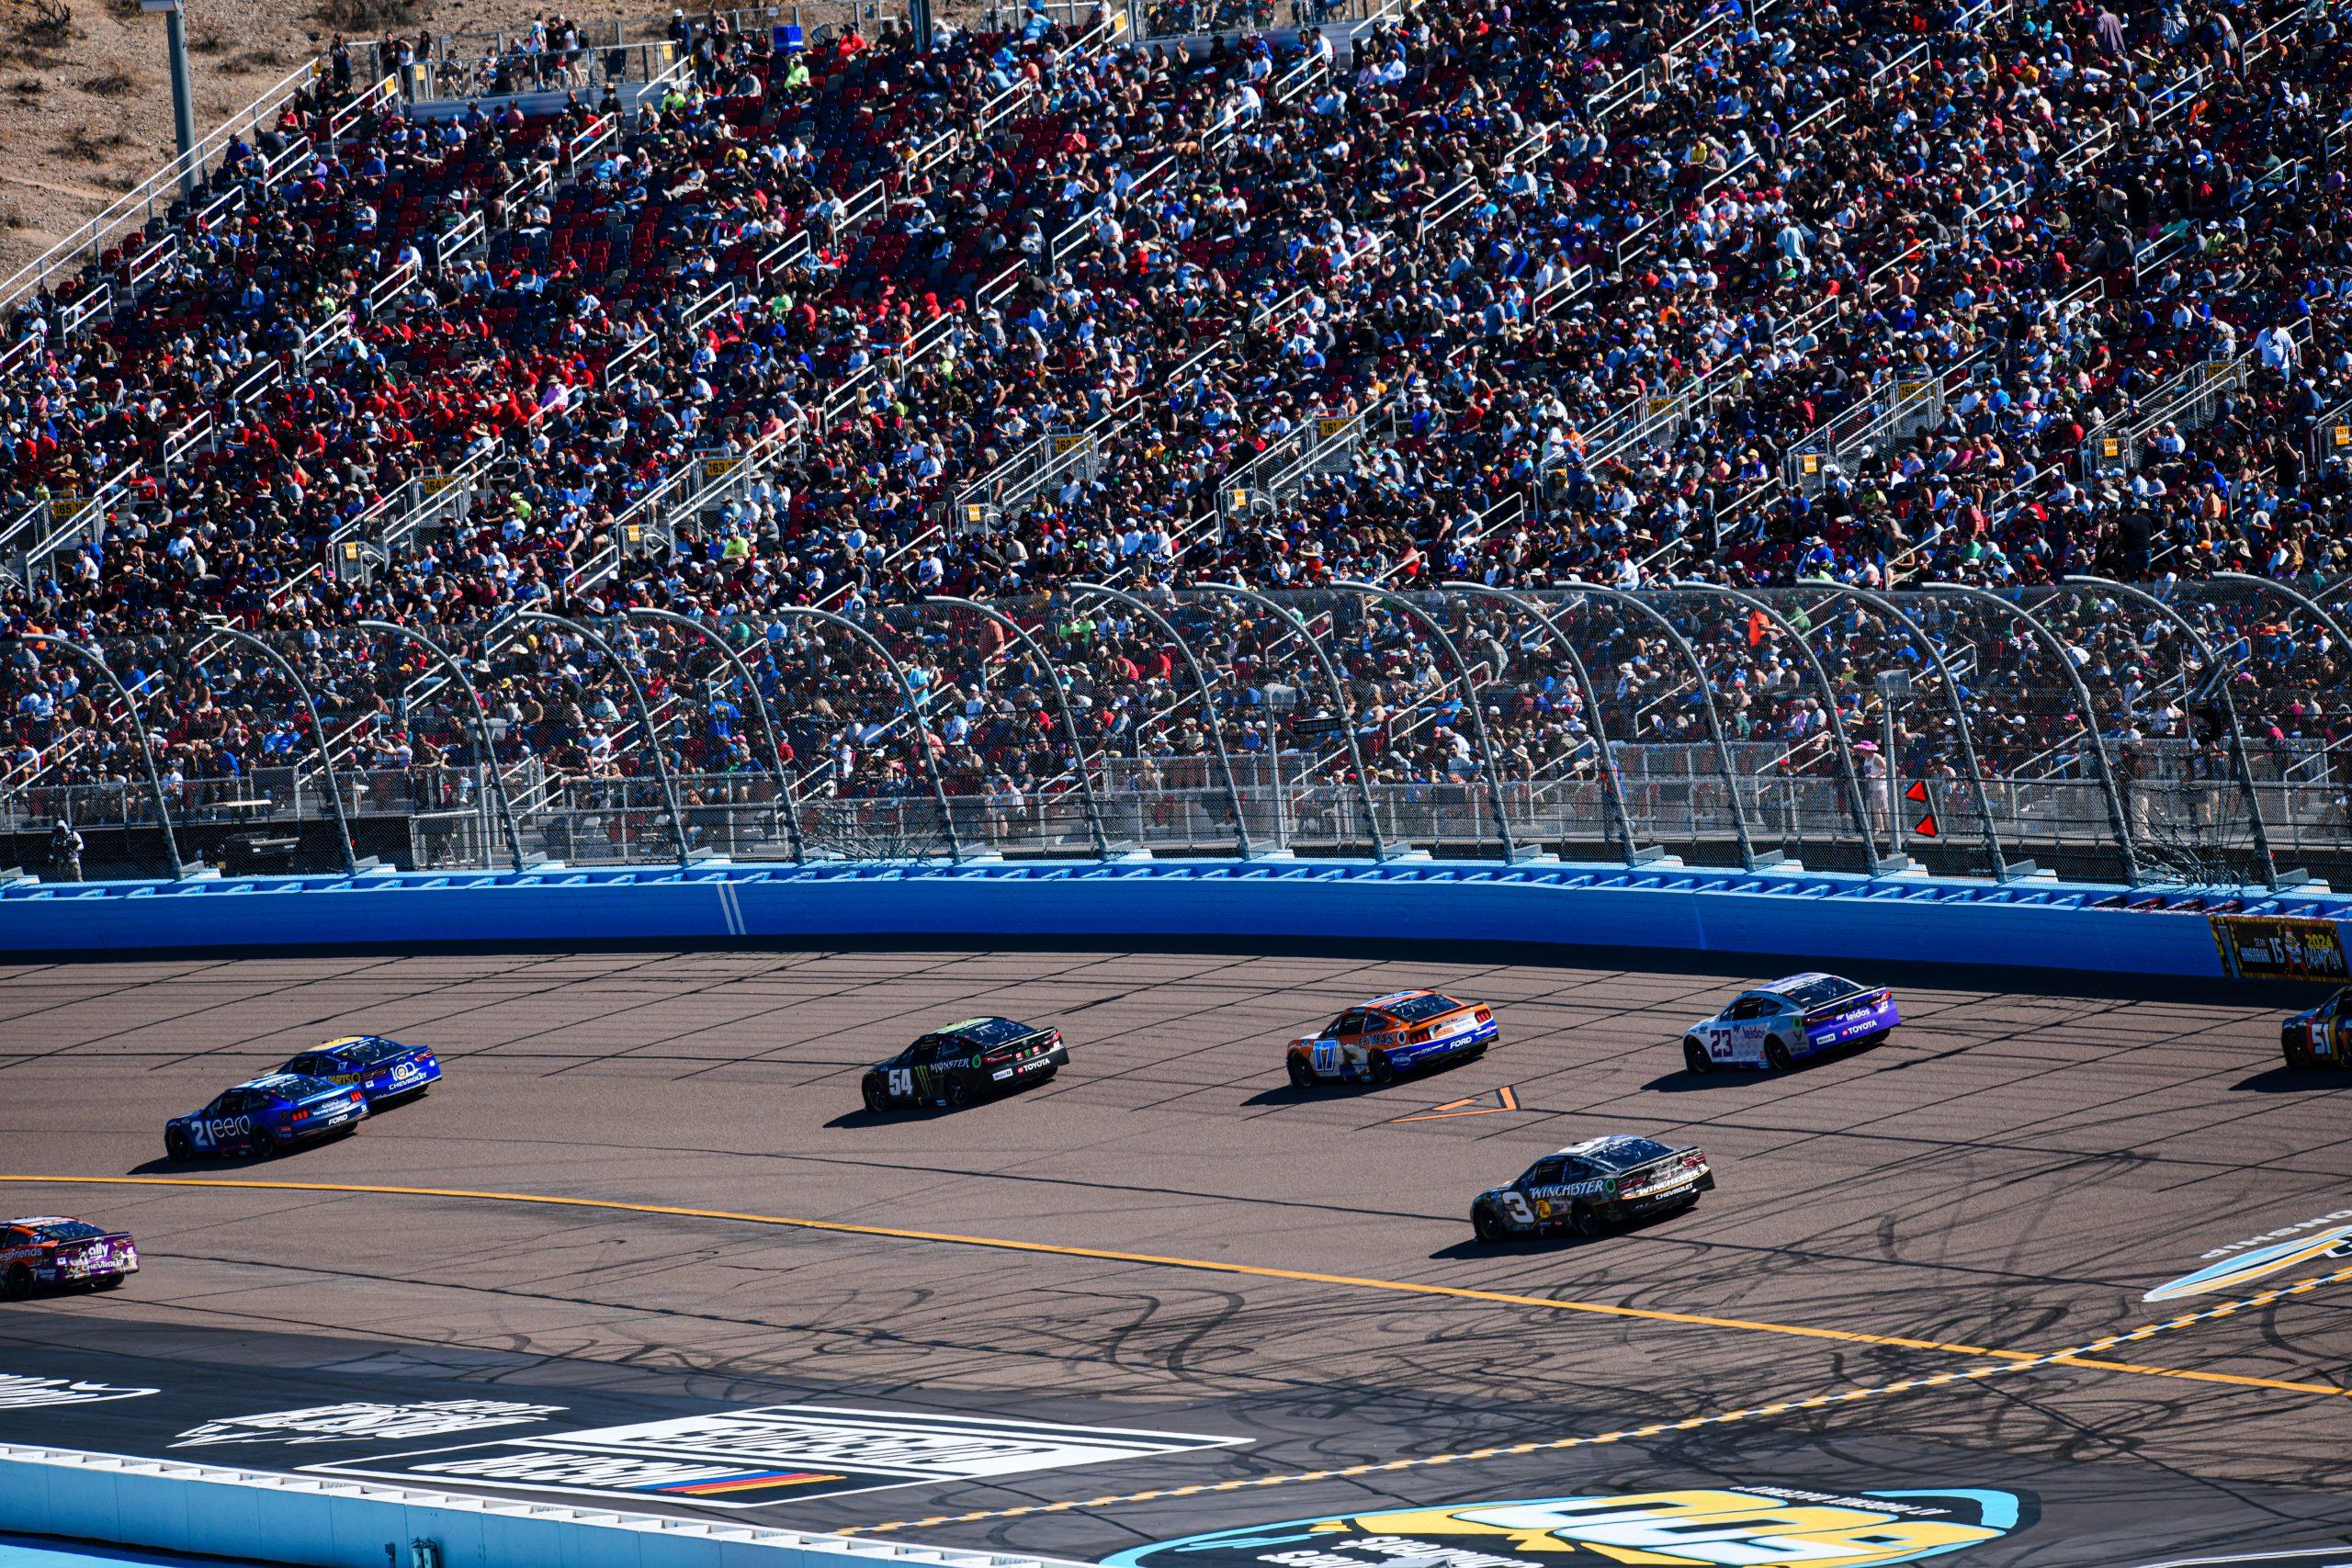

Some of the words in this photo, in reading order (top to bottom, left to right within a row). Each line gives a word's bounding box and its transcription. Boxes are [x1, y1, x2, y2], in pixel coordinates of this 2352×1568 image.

[709, 461, 725, 473] 163
[425, 480, 442, 491] 164
[55, 503, 72, 515] 165
[2269, 937, 2285, 964] 15
[2304, 934, 2334, 950] 2024
[1846, 1008, 1871, 1021] leidos
[1848, 1020, 1878, 1035] TOYOTA
[1450, 1036, 1473, 1050] FORD
[1710, 1030, 1734, 1057] 23
[2312, 1023, 2333, 1055] 51
[1314, 1040, 1337, 1071] 17
[930, 1058, 970, 1074] MONSTER
[1023, 1058, 1051, 1072] TOYOTA
[389, 1071, 427, 1090] CHEVROLET
[888, 1068, 913, 1096] 54
[212, 1115, 251, 1138] eero
[328, 1113, 348, 1126] FORD
[191, 1121, 216, 1146] 21
[1530, 1179, 1604, 1199] WINCHESTER
[1635, 1169, 1700, 1196] WINCHESTER
[1656, 1183, 1693, 1201] CHEVROLET
[1502, 1191, 1534, 1224] 3
[88, 1243, 109, 1258] ally
[1450, 1489, 2007, 1566] 500
